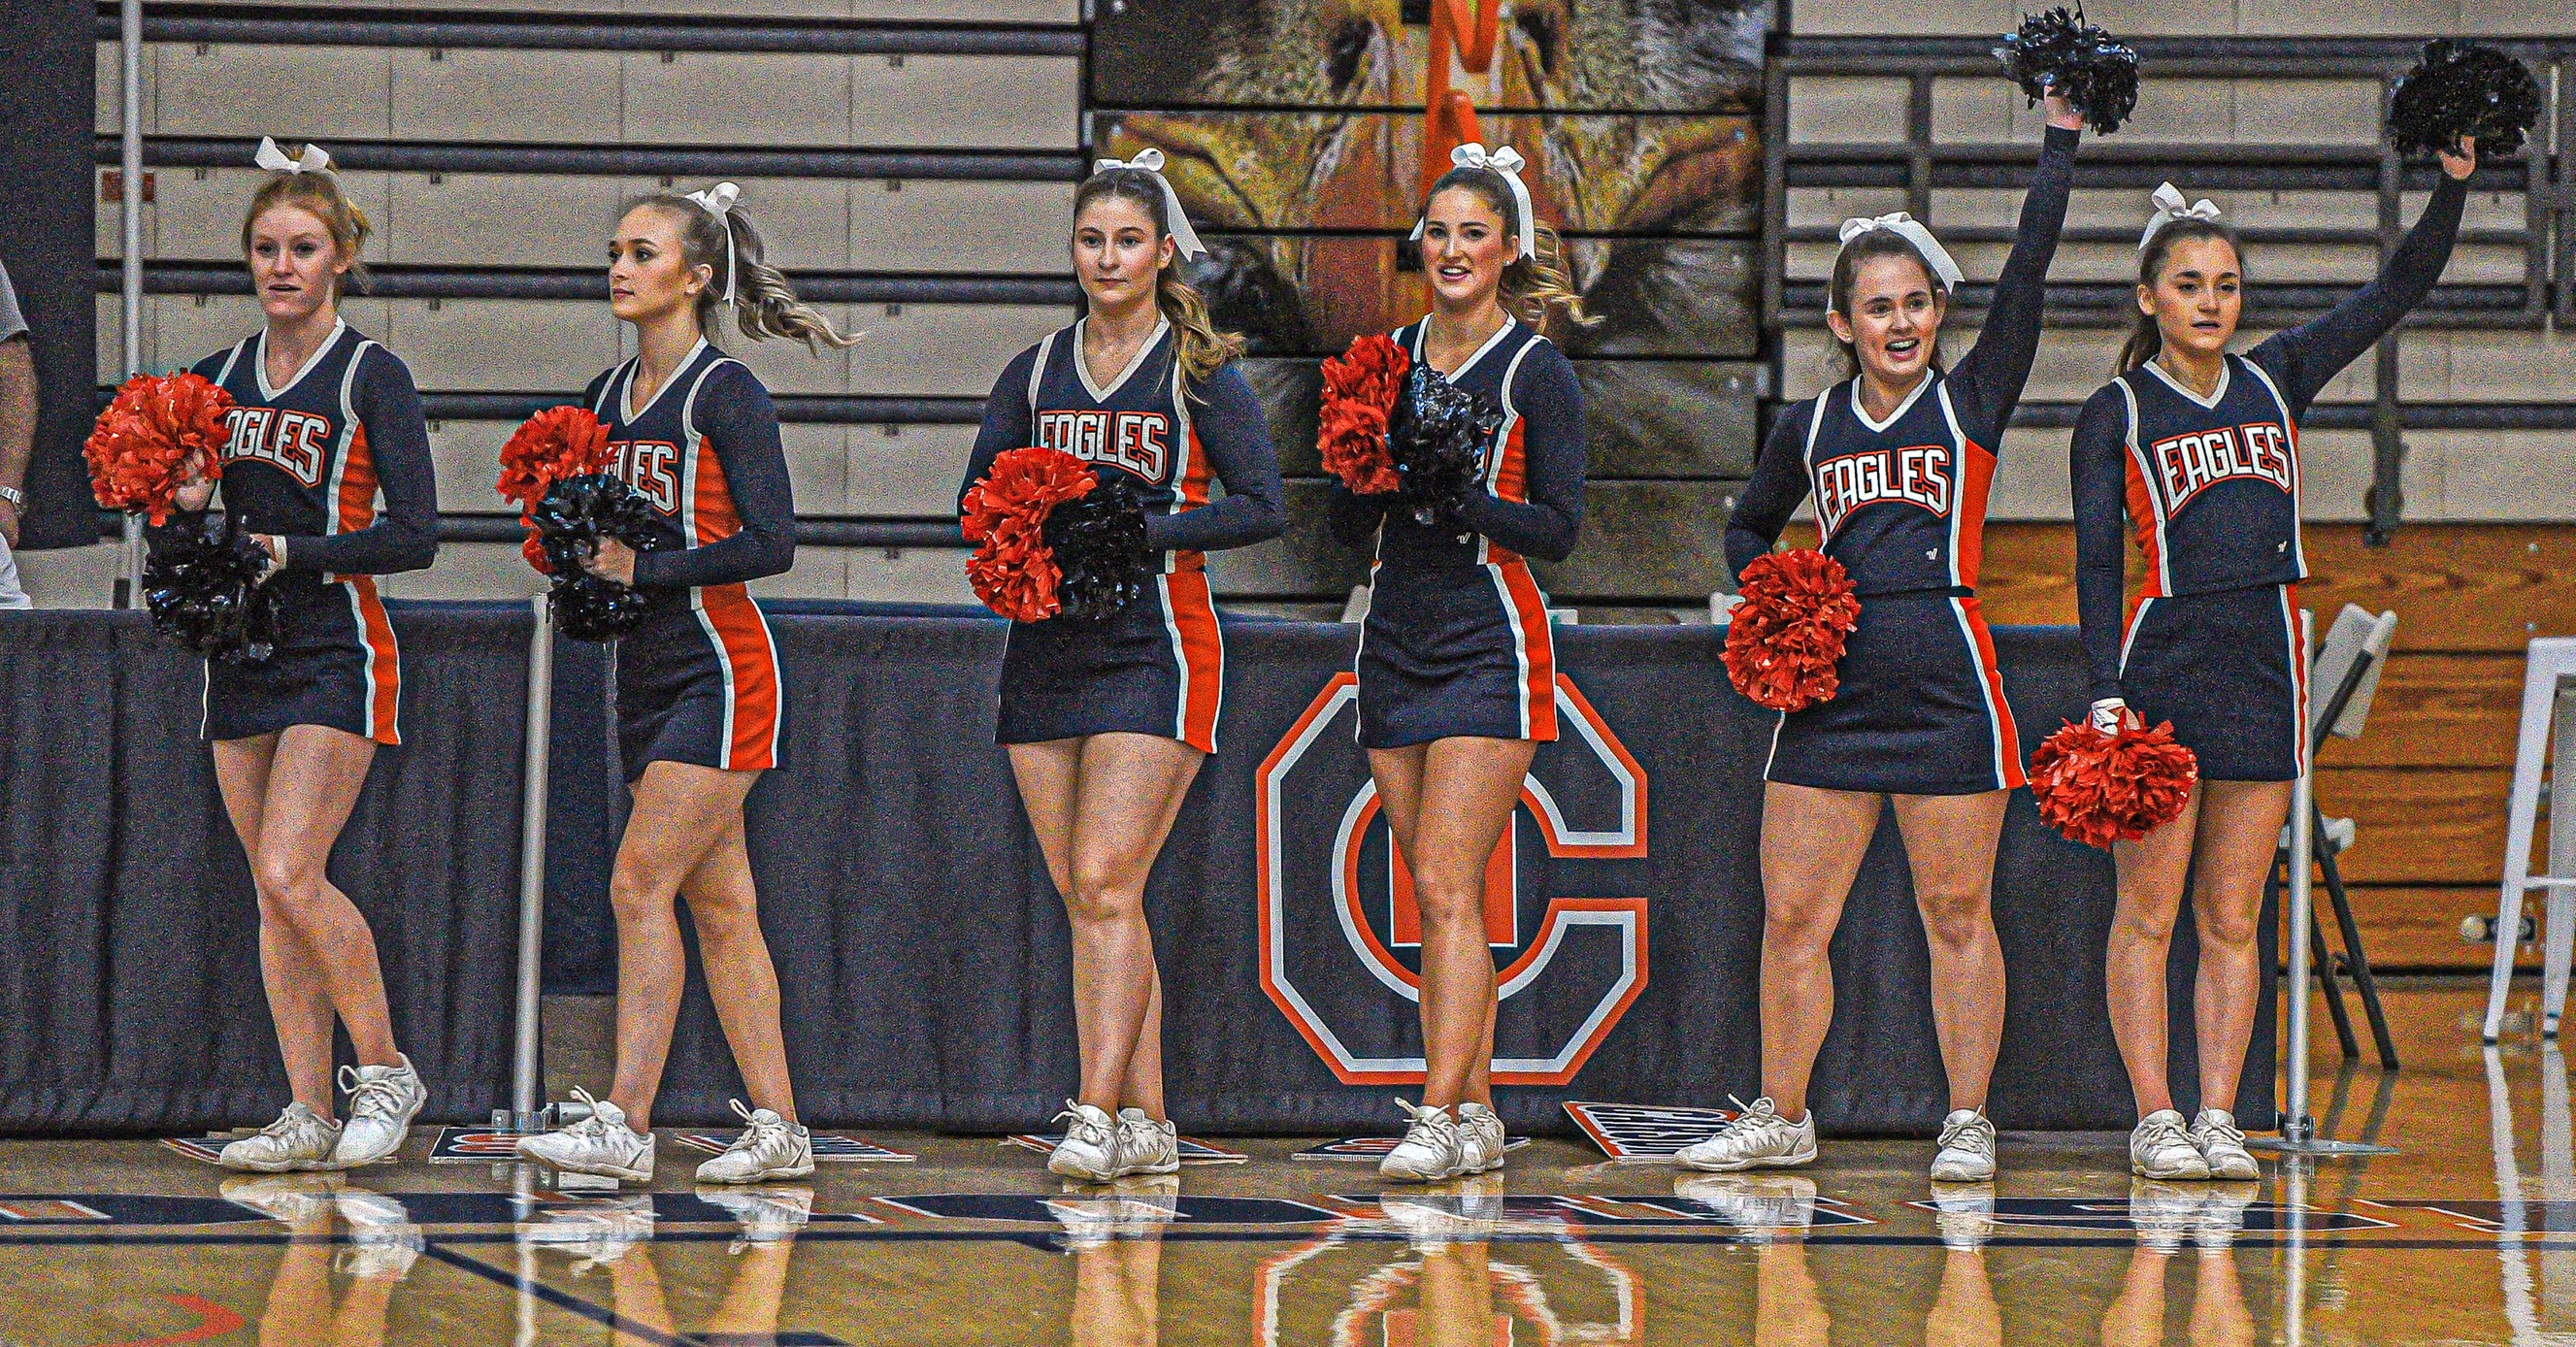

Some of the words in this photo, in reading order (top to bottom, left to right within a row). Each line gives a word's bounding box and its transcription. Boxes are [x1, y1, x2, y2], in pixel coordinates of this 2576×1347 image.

[221, 406, 331, 488] AGLES
[1816, 444, 1951, 537] EAGLES
[2151, 422, 2292, 520] EAGLES
